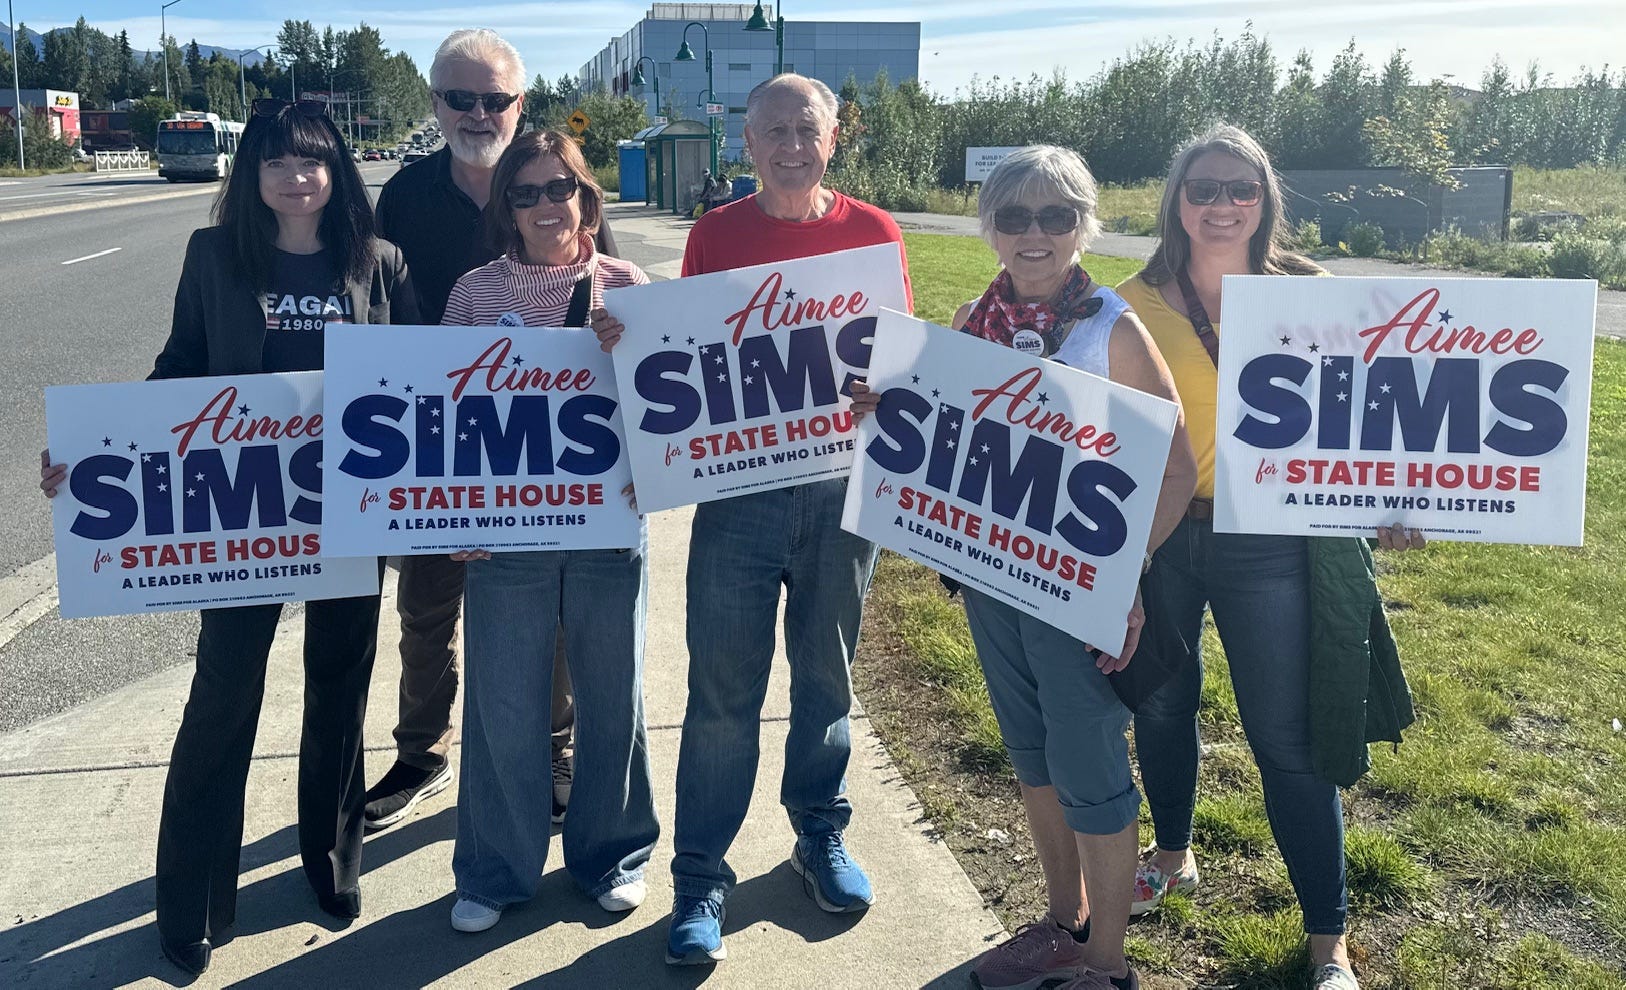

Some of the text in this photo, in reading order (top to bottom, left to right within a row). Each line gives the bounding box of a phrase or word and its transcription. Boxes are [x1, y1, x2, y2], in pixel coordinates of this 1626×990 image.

[266, 293, 350, 315] EAGA
[282, 319, 323, 330] 1980
[724, 272, 868, 346] Aimee
[1359, 288, 1544, 364] Aimee
[447, 337, 596, 402] Aimee
[1016, 340, 1040, 349] SIMS
[634, 316, 878, 434] SIMS
[170, 386, 323, 457] Aimee
[972, 368, 1121, 456] Aimee
[1232, 354, 1570, 457] SIMS
[338, 394, 620, 480] SIMS
[665, 411, 852, 466] for STATE HOU
[693, 439, 856, 478] A LEADER WHO LISTE
[360, 484, 604, 513] for STATE HOUSE
[866, 388, 1138, 557] SIMS
[1256, 458, 1540, 492] for STATE HOUSE
[388, 514, 586, 530] A LEADER WHO LISTENS
[1285, 493, 1516, 513] A LEADER WHO LISTENS
[94, 534, 320, 573] for STATE HOUS
[876, 477, 1097, 591] for STATE HOUSE
[894, 515, 1071, 602] A LEADER WHO LISTENS
[122, 563, 322, 589] A LEADER WHO LISTENS
